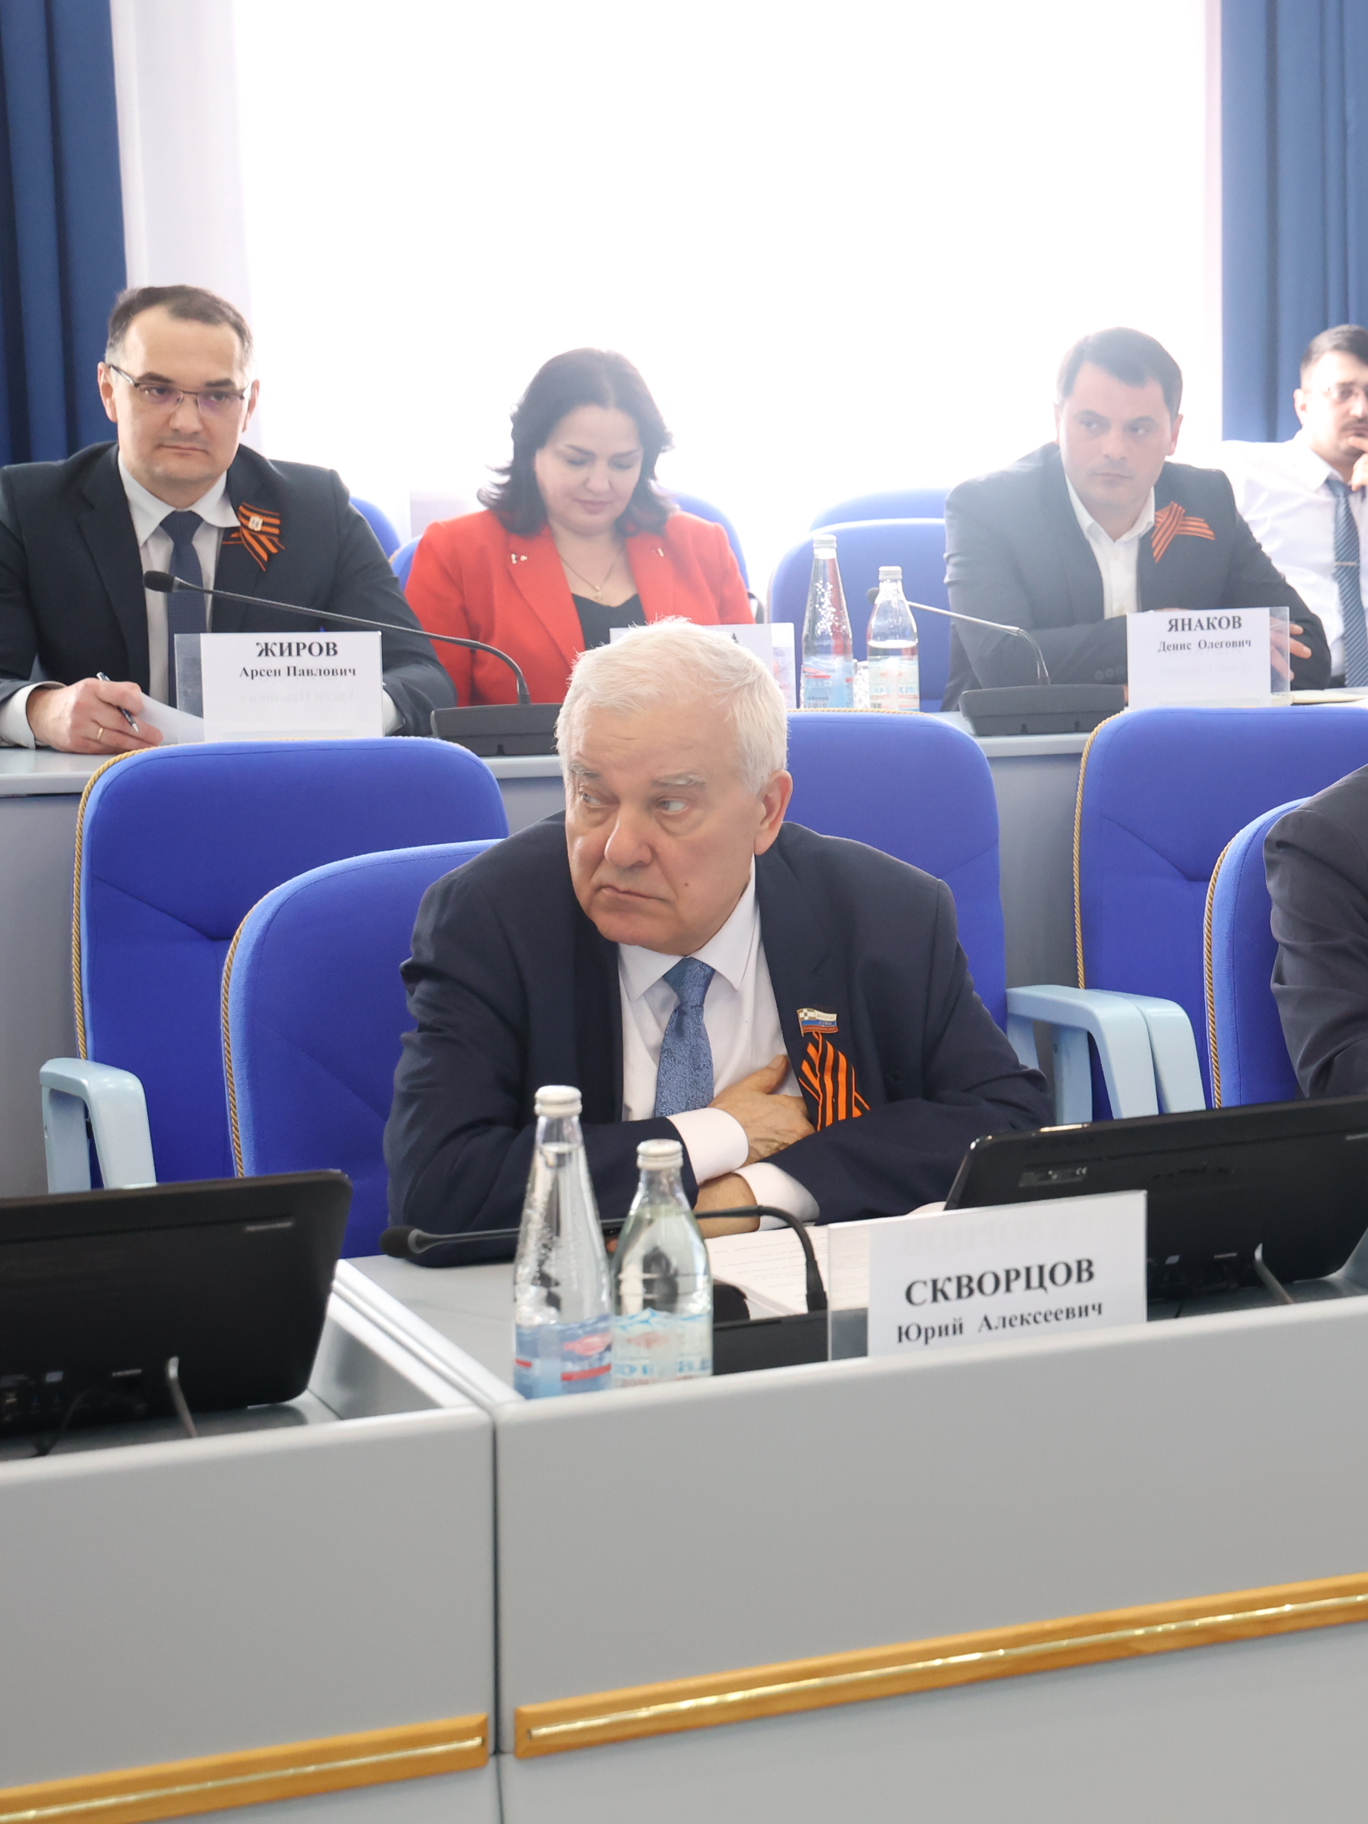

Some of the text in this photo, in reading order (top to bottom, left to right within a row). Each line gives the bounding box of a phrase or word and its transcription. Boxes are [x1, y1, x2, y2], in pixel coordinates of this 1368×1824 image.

[1167, 616, 1242, 633] ЯНАКОВ
[256, 641, 339, 658] ЖИРОВ
[1157, 639, 1252, 653] Денис Олегович
[239, 665, 356, 680] Арсен Павлович
[905, 1258, 1095, 1306] СКВОРЦОВ
[897, 1302, 1102, 1345] Юрий Алексеевич
